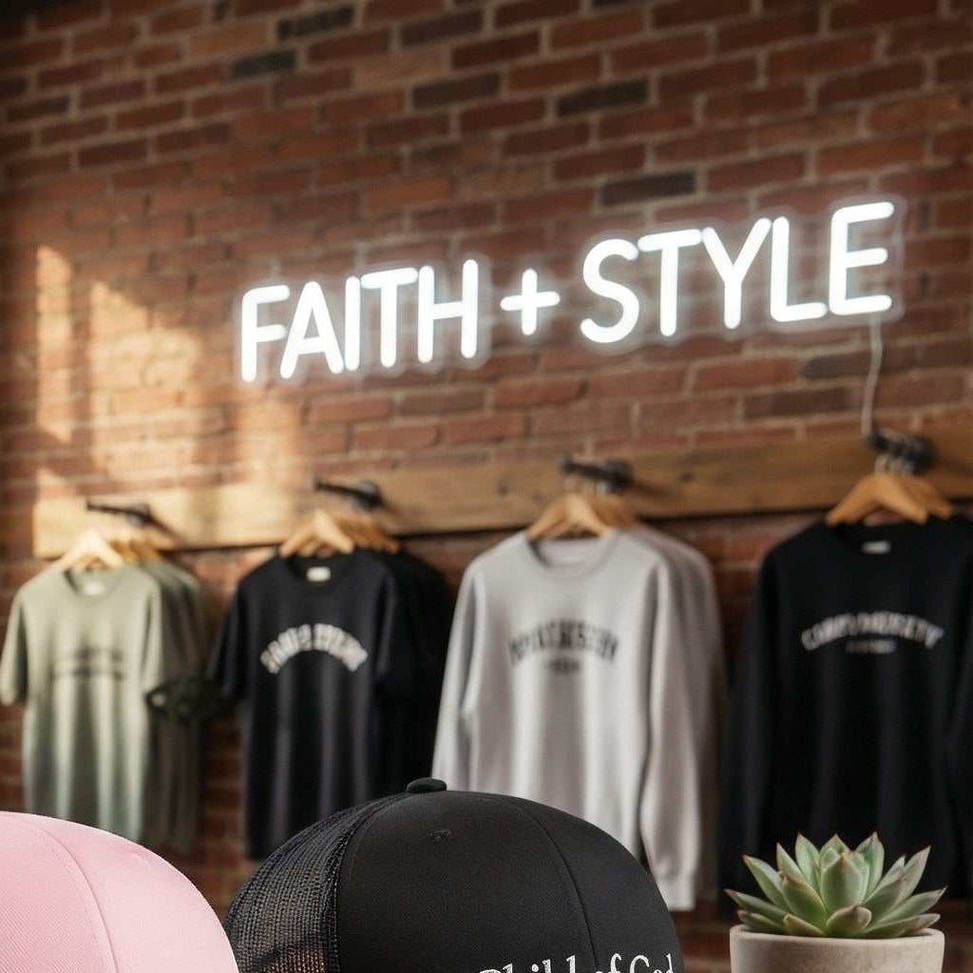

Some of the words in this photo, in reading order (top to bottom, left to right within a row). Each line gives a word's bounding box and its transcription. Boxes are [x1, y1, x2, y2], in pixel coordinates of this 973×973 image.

[240, 258, 479, 383] FAITH
[500, 268, 561, 336] +
[580, 201, 895, 344] STYLE
